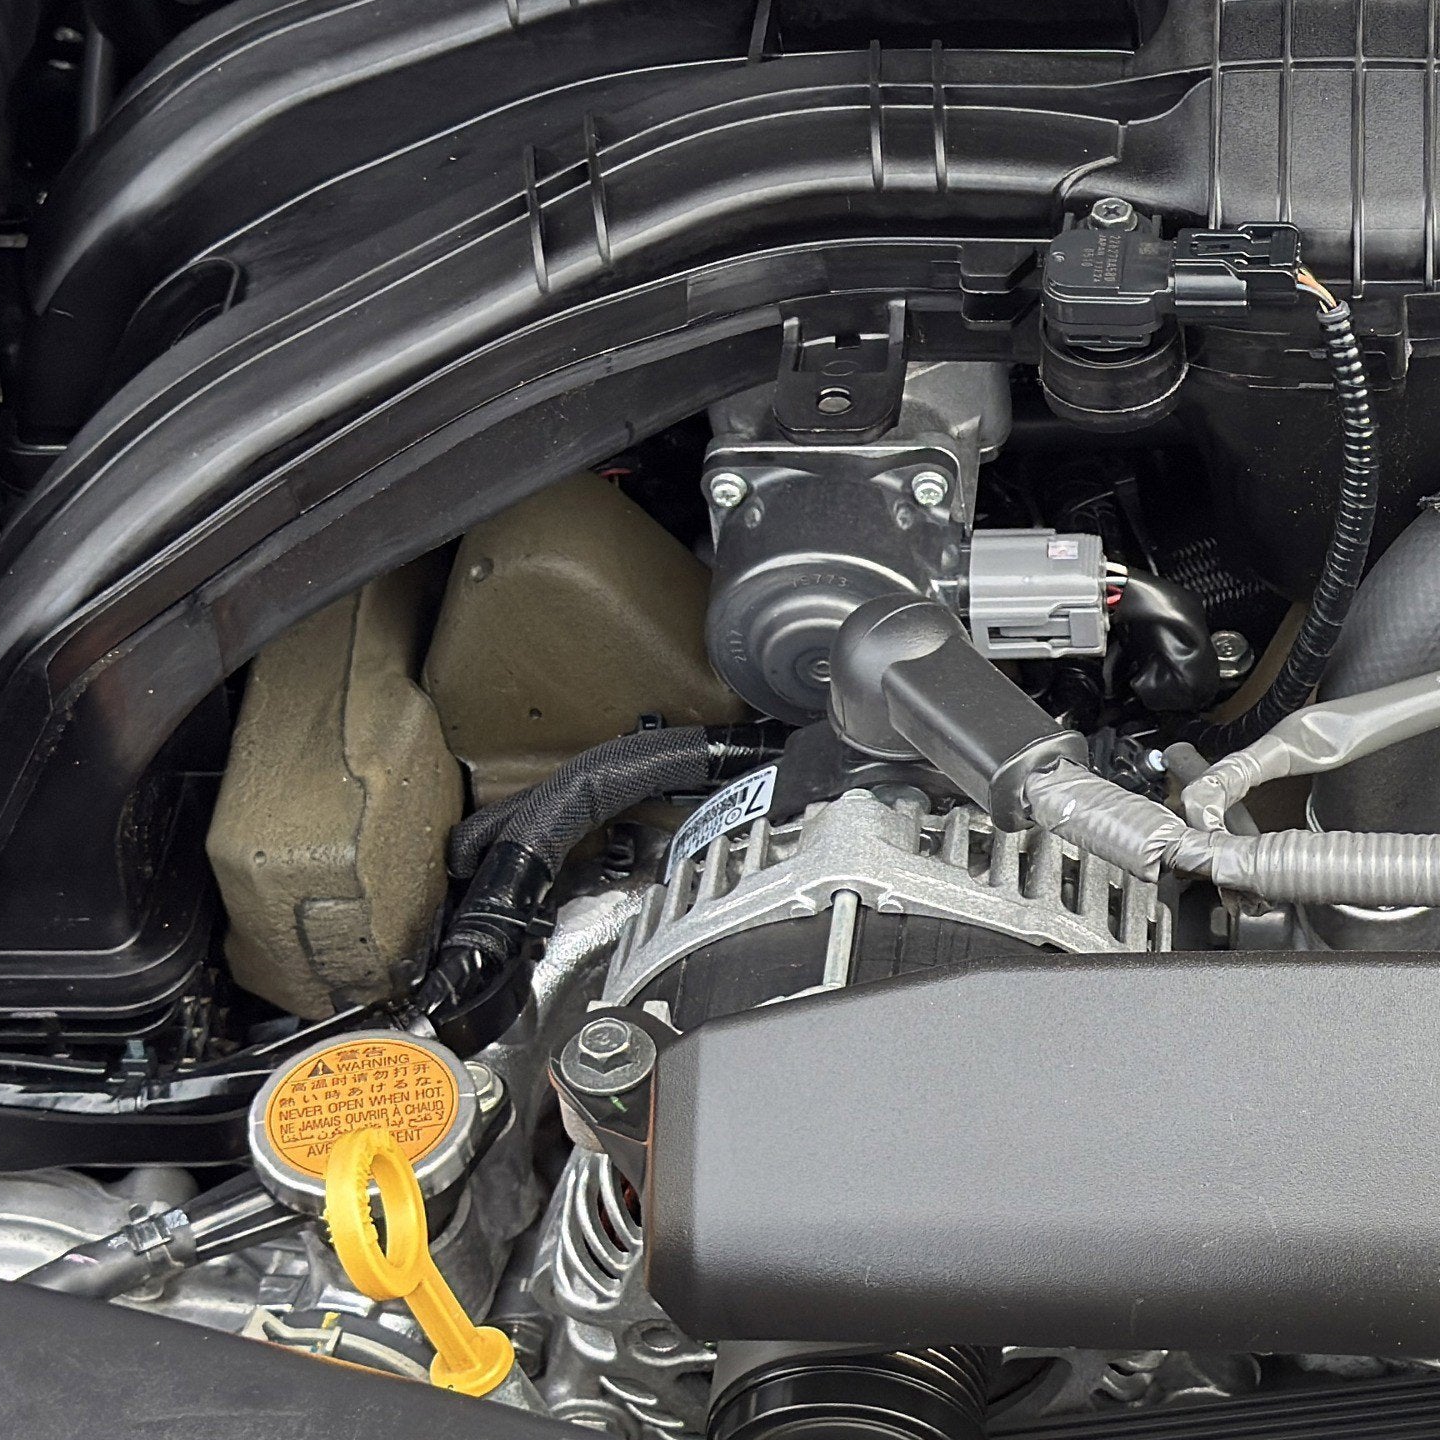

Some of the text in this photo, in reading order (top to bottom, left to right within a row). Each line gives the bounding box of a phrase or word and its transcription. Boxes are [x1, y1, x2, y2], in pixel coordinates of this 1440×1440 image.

[336, 1053, 410, 1073] WARNING
[280, 1086, 446, 1121] NEVER OPEN WHEN HOT.
[280, 1122, 295, 1136] NE
[298, 1114, 341, 1133] JAMAIS
[345, 1108, 388, 1124] OUVRIR
